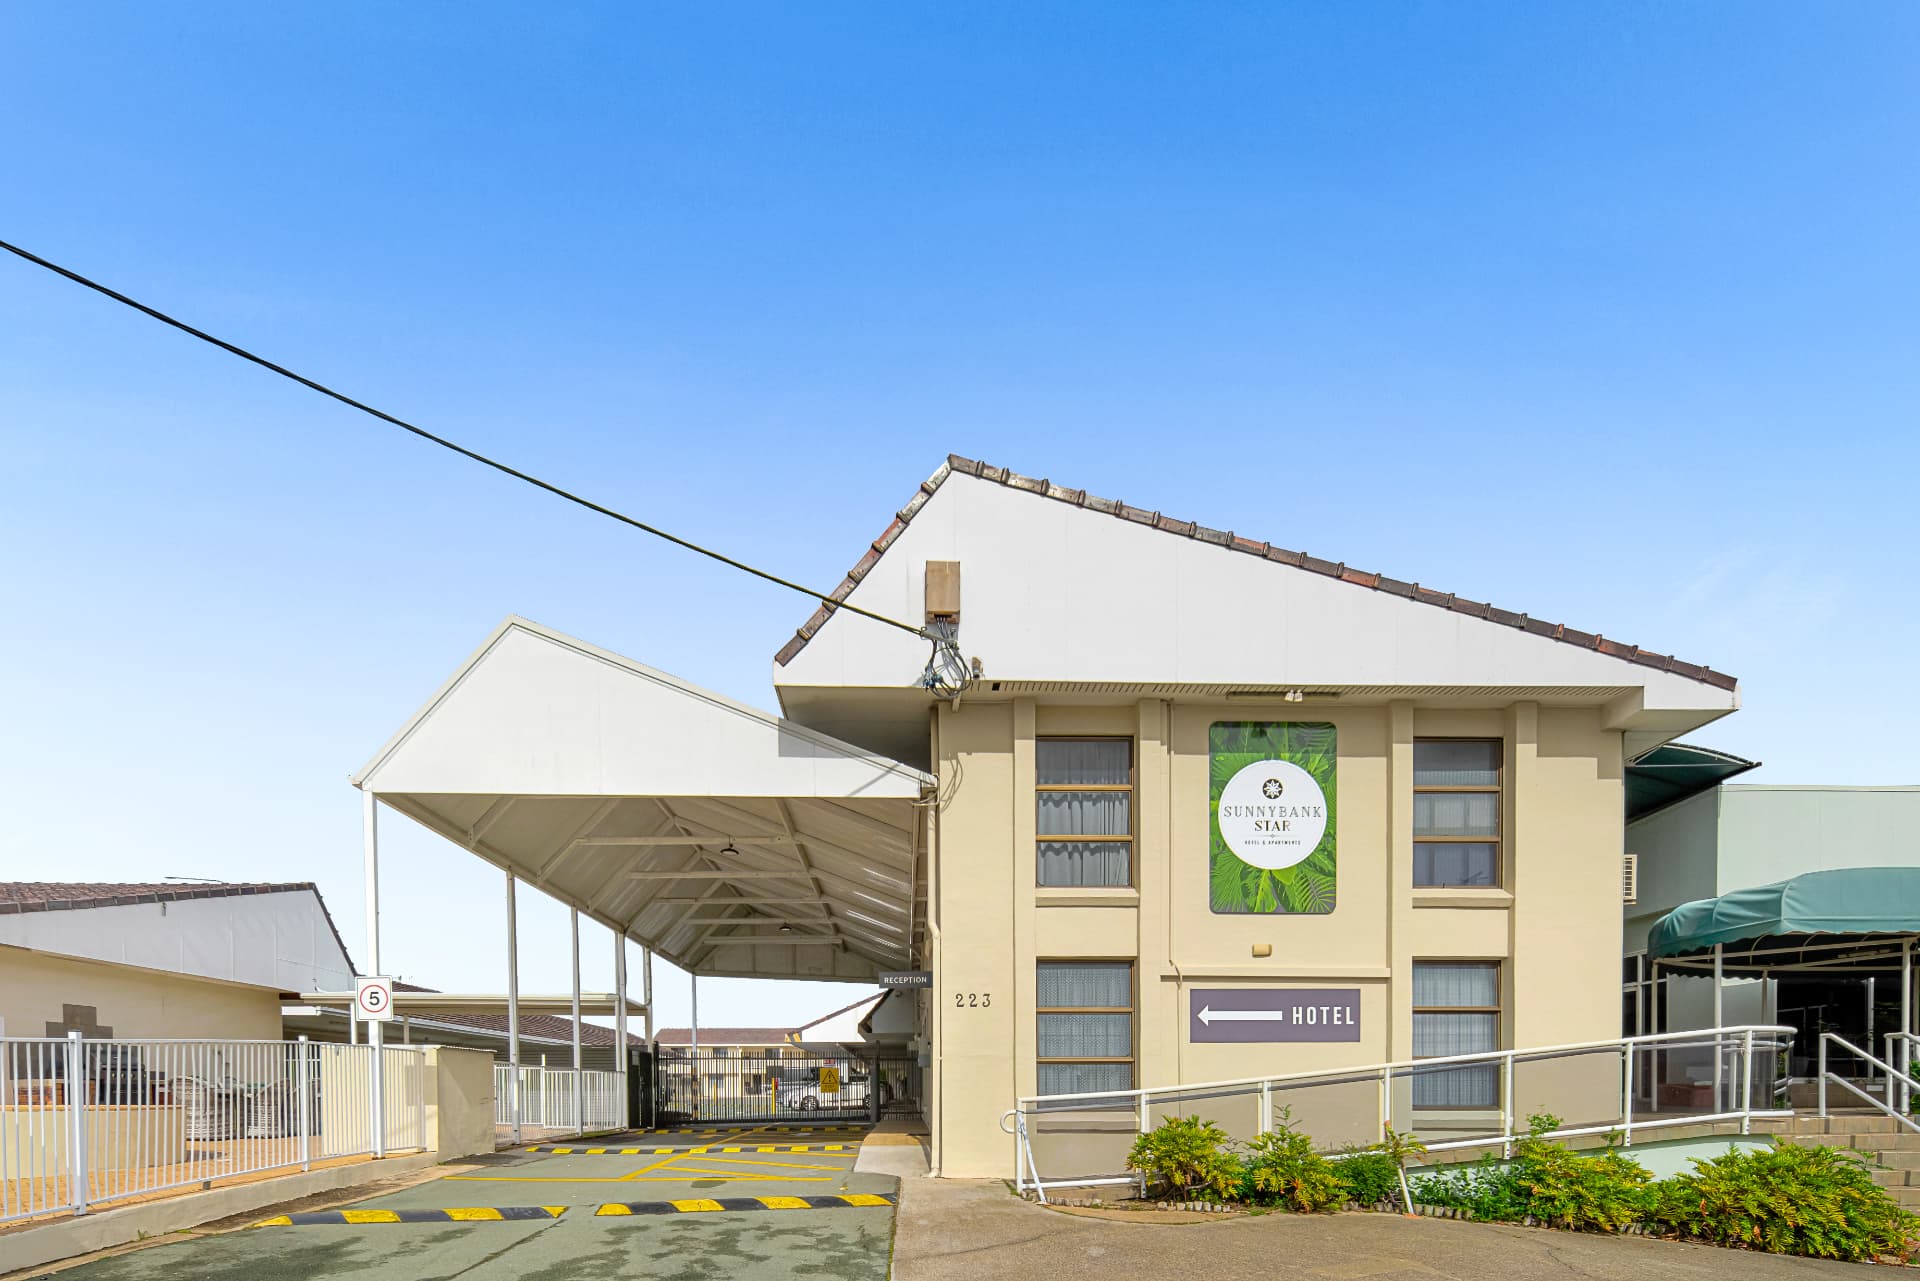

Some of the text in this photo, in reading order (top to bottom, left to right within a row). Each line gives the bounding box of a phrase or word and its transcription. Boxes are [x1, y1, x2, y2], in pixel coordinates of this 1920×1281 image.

[1223, 806, 1322, 818] SUNNYBANK
[1254, 820, 1291, 832] STAR
[884, 976, 927, 984] RECEPTION
[369, 991, 380, 1006] 5
[955, 993, 991, 1008] 223
[1292, 1006, 1355, 1025] HOTEL
